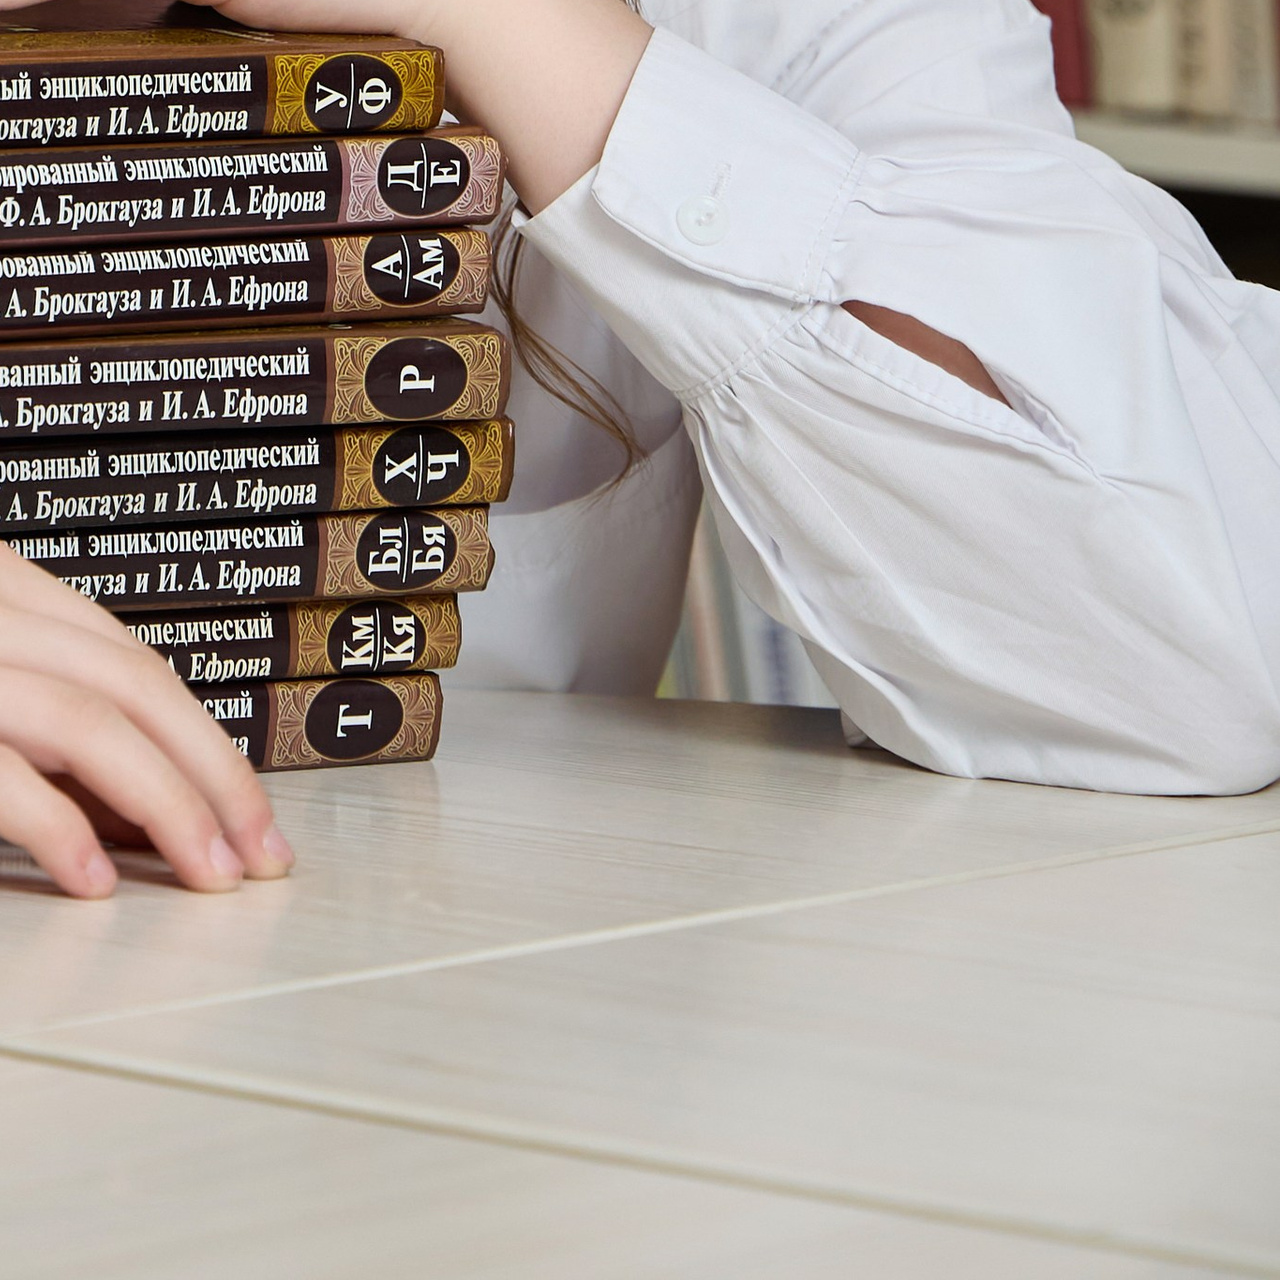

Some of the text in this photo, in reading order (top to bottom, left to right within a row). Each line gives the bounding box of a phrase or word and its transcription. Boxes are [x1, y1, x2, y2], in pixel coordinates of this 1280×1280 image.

[39, 63, 252, 102] энциклопедический
[314, 81, 348, 114] У
[358, 76, 392, 115] Ф
[85, 116, 101, 137] и
[106, 106, 133, 136] И.
[137, 105, 160, 135] А.
[165, 104, 248, 139] Ефрона
[123, 144, 329, 184] энциклопедический
[386, 158, 425, 193] Д
[429, 158, 461, 189] Е
[28, 196, 52, 226] А.
[56, 194, 163, 231] Брокгауза
[170, 197, 185, 219] и
[190, 187, 217, 218] И.
[219, 186, 242, 216] А.
[246, 184, 326, 221] Ефрона
[100, 238, 310, 275] энциклопедический
[371, 249, 403, 281] А
[412, 237, 443, 290] Ам
[4, 288, 27, 318] А.
[32, 286, 142, 322] Брокгауза
[149, 288, 164, 310] и
[170, 278, 196, 309] И.
[199, 277, 222, 307] А.
[227, 275, 309, 311] Ефрона
[89, 346, 310, 386] энциклопедический
[399, 363, 436, 394] Р
[14, 397, 130, 433] Брокгауза
[138, 400, 154, 422] и
[160, 390, 188, 421] И.
[192, 389, 216, 419] А.
[221, 387, 308, 424] Ефрона
[108, 437, 320, 478] энциклопедический
[384, 451, 418, 484] Х
[426, 448, 460, 484] Ч
[5, 492, 28, 522] А.
[33, 490, 146, 525] Брокгауза
[153, 492, 169, 513] и
[175, 482, 201, 512] И.
[205, 481, 228, 510] А.
[233, 478, 317, 514] Ефрона
[87, 519, 304, 559] энциклопедический
[367, 526, 403, 577] Бл
[411, 523, 448, 574] Бя
[58, 559, 301, 603] гауза и И. А. Ефрона
[126, 610, 274, 648] опедический
[340, 613, 375, 671] Км
[382, 613, 417, 665] Кя
[187, 651, 273, 683] Ефрона
[336, 703, 374, 739] Т
